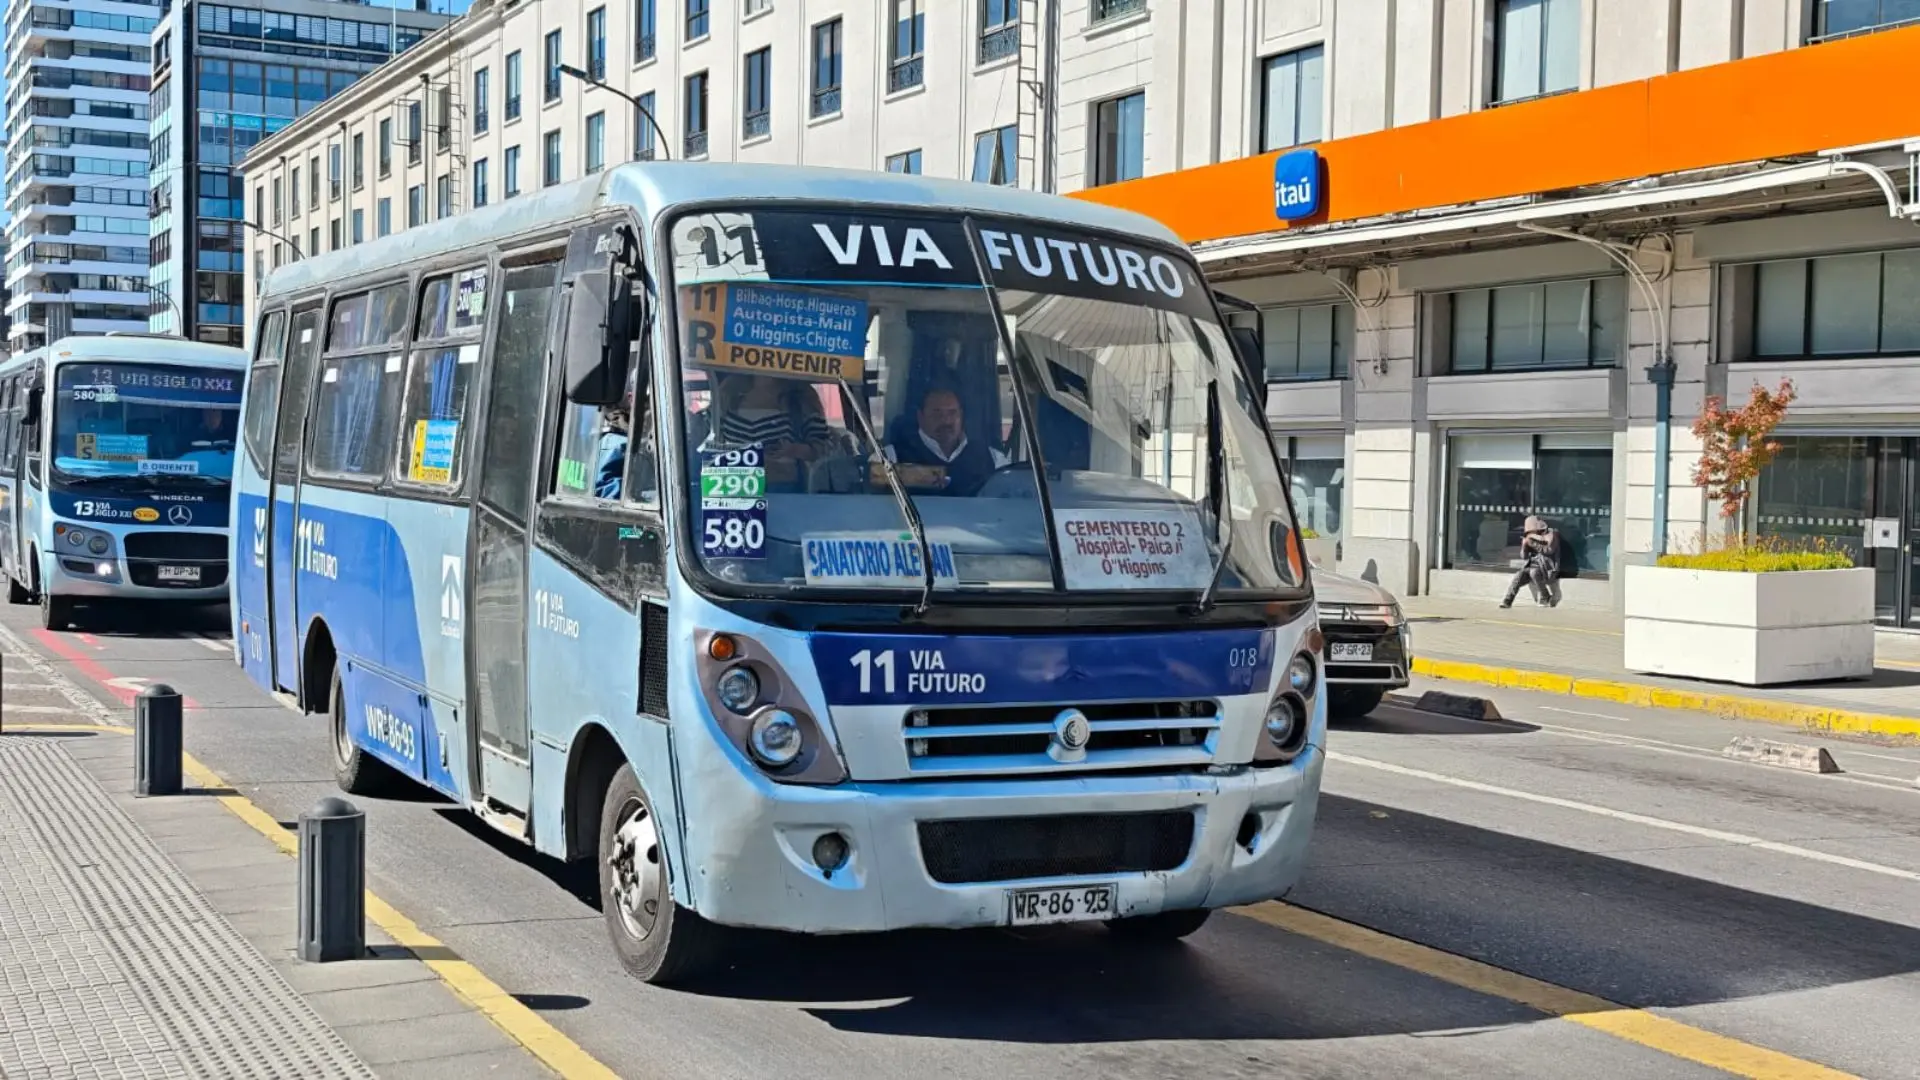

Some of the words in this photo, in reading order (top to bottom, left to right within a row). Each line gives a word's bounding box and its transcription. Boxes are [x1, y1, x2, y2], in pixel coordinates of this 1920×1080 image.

[1275, 177, 1311, 208] itaú
[813, 223, 951, 269] VIA
[980, 230, 1185, 299] FUTURO
[690, 286, 718, 312] 11
[733, 307, 853, 332] Autopista-Mall
[688, 320, 716, 360] R
[730, 346, 842, 374] PORVENIR
[120, 372, 149, 385] VIA
[152, 375, 201, 389] SIGLO
[204, 378, 233, 391] XXI
[73, 390, 95, 400] 580
[151, 463, 196, 472] ORIENTE
[708, 475, 759, 496] 290
[73, 501, 95, 516] 13
[94, 509, 118, 518] SIGLO
[313, 521, 325, 546] VIA
[704, 518, 764, 549] 580
[1065, 521, 1171, 536] CEMENTERIO
[1173, 522, 1185, 537] 2
[299, 517, 312, 571] 11
[312, 550, 338, 579] FUTURO
[806, 540, 892, 577] SANATORIO
[895, 541, 955, 578] ALEAN
[535, 589, 548, 628] 11
[550, 592, 564, 613] VIA
[549, 612, 579, 638] FUTURO
[909, 650, 945, 670] VIA
[1230, 647, 1257, 667] 018
[849, 649, 895, 693] 11
[908, 673, 986, 693] FUTURO
